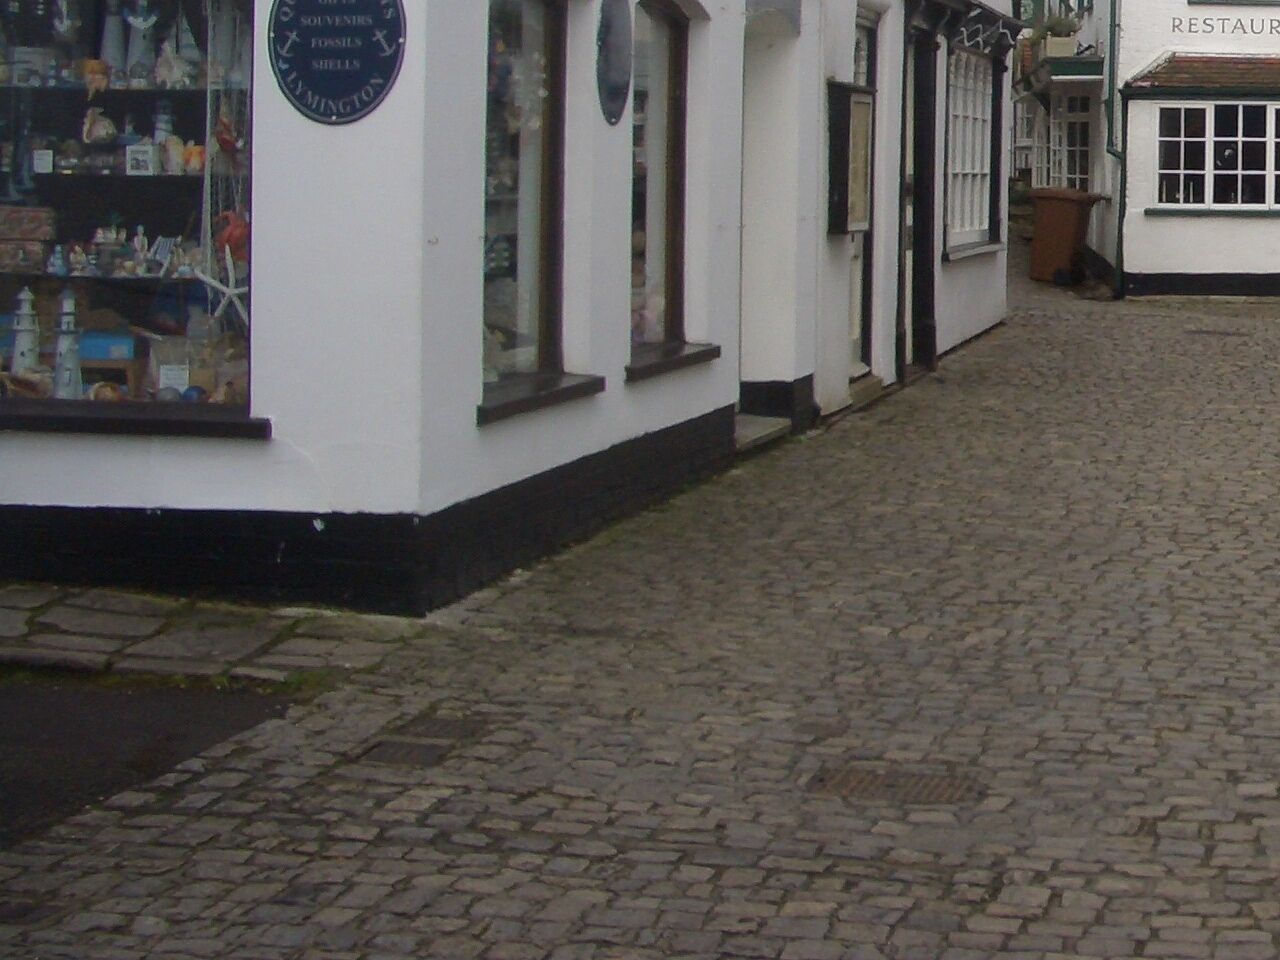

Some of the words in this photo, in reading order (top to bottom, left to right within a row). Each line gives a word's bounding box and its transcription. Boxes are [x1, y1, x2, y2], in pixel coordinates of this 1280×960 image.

[300, 14, 373, 27] SOUVENIRS
[311, 37, 363, 49] FOSSILS
[311, 58, 361, 71] SHELLS
[286, 70, 385, 114] LYMINGTON
